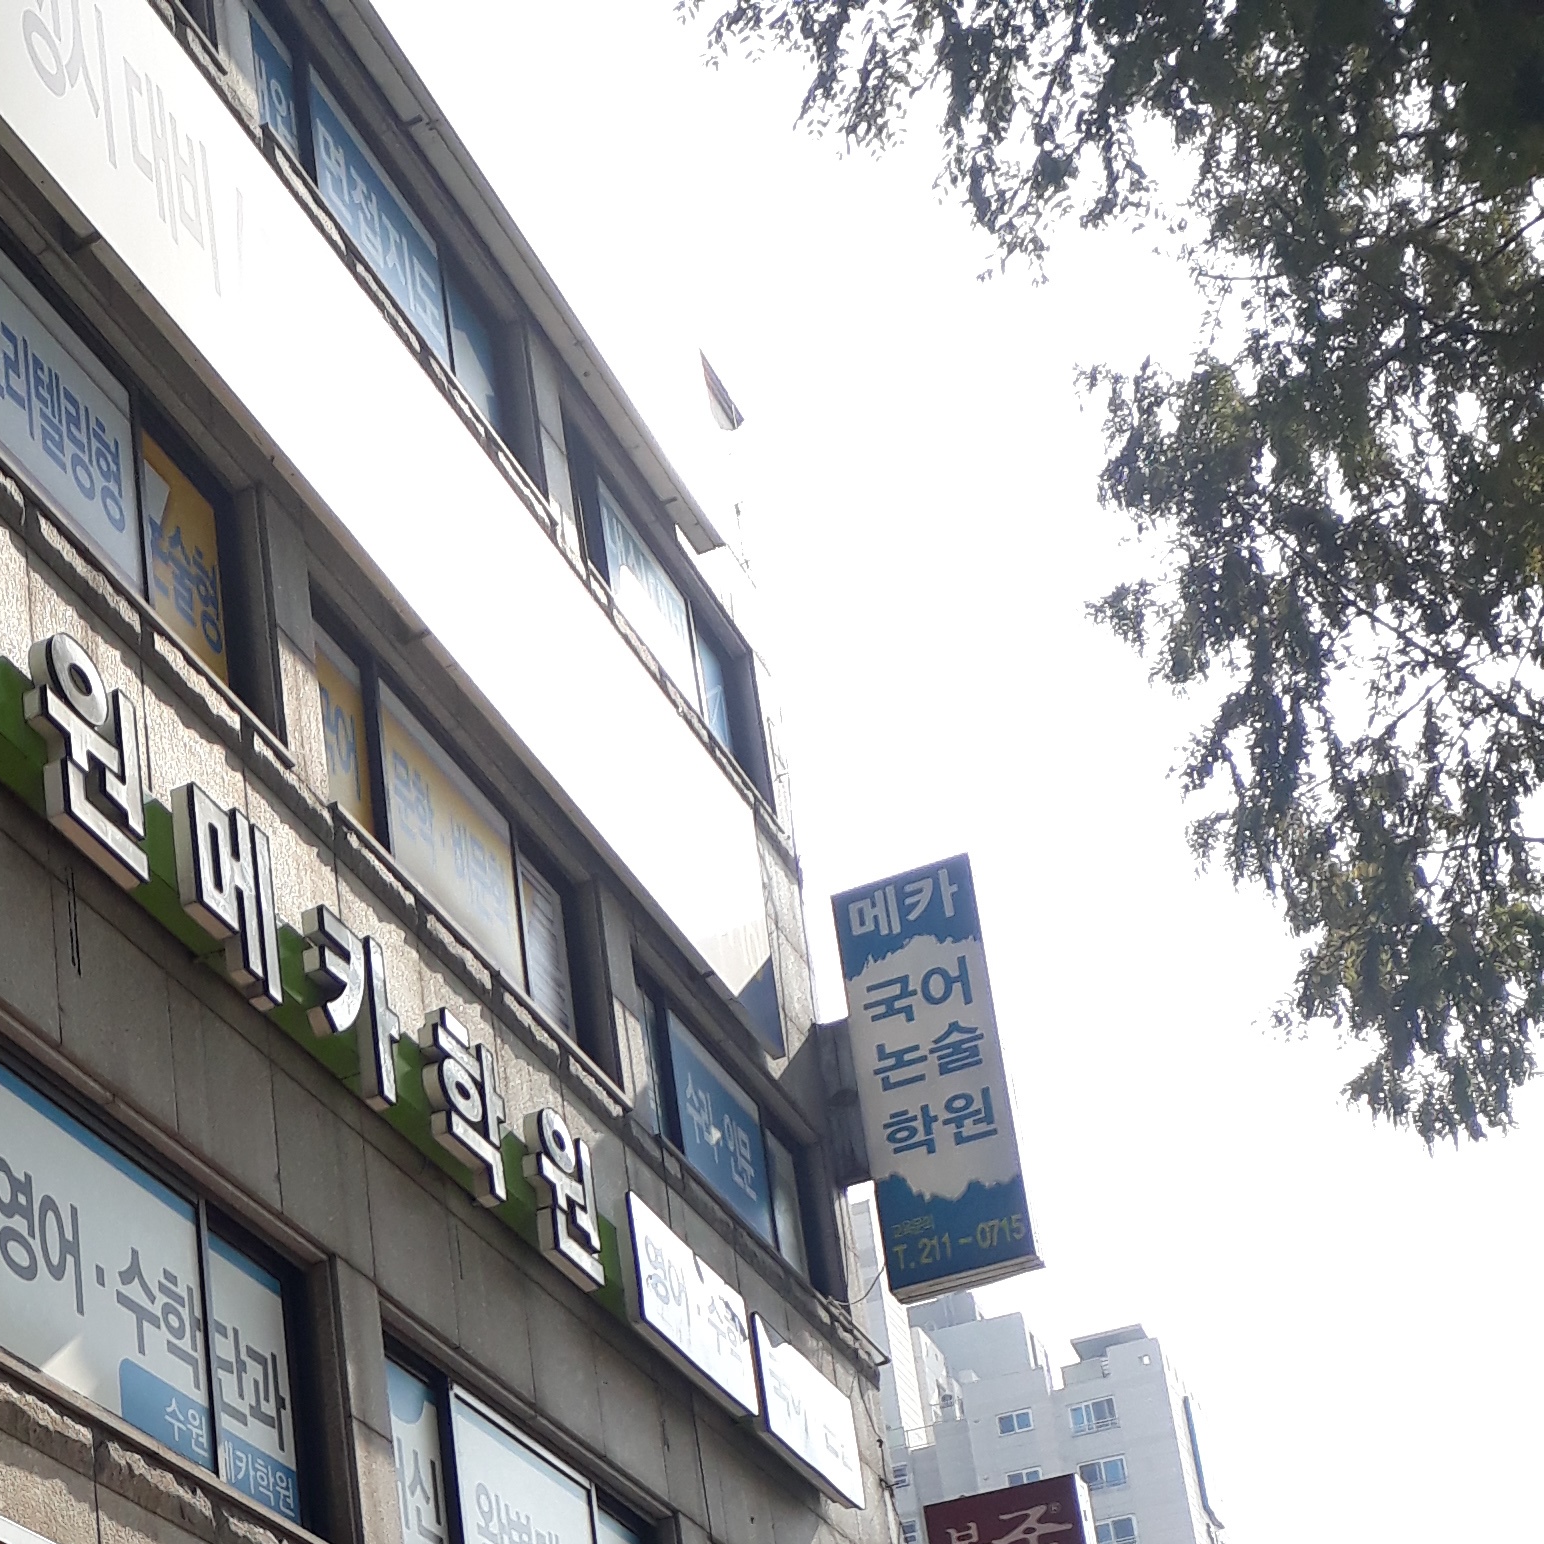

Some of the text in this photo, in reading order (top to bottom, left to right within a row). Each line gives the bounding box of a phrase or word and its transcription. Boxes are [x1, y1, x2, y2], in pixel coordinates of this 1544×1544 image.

[849, 867, 959, 937] 메카
[863, 955, 973, 1023] 국어
[872, 1020, 985, 1093] 논술
[882, 1085, 998, 1155] 학원
[164, 1400, 209, 1459] 수원
